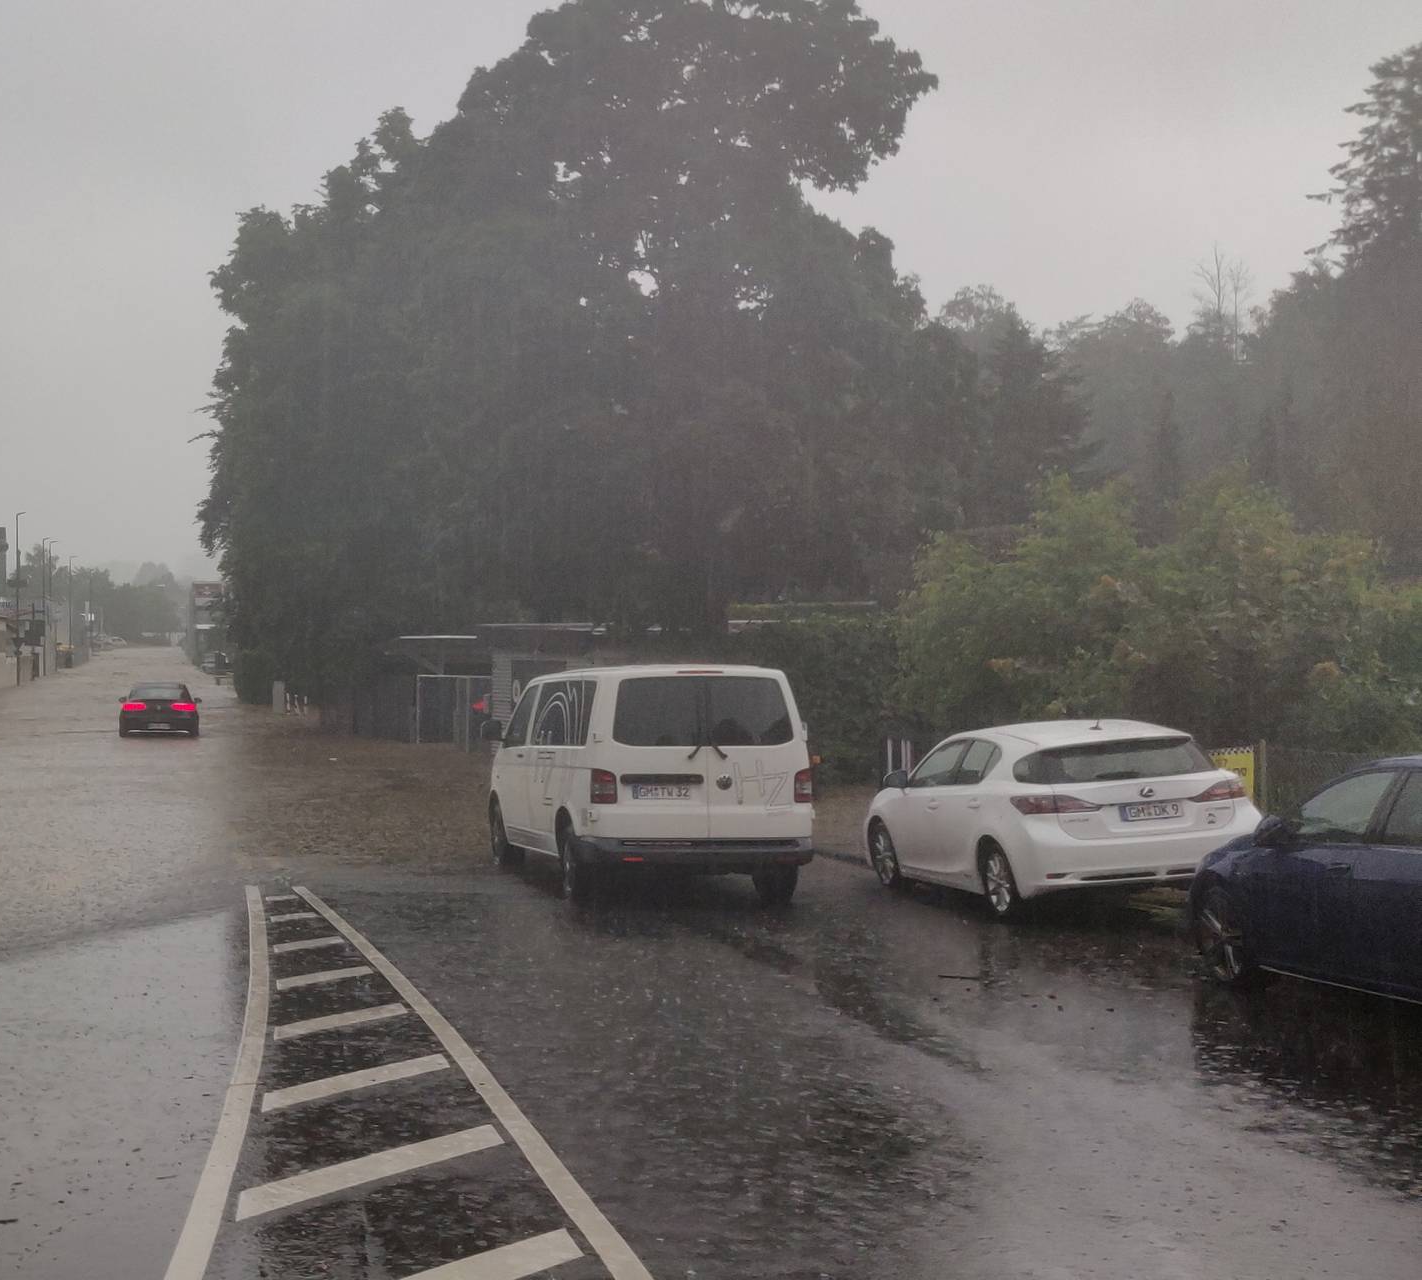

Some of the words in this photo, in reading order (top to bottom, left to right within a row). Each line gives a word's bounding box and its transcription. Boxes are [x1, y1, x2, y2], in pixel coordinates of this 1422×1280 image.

[676, 786, 690, 797] 32
[1130, 806, 1146, 817] GM
[1171, 803, 1179, 815] 9
